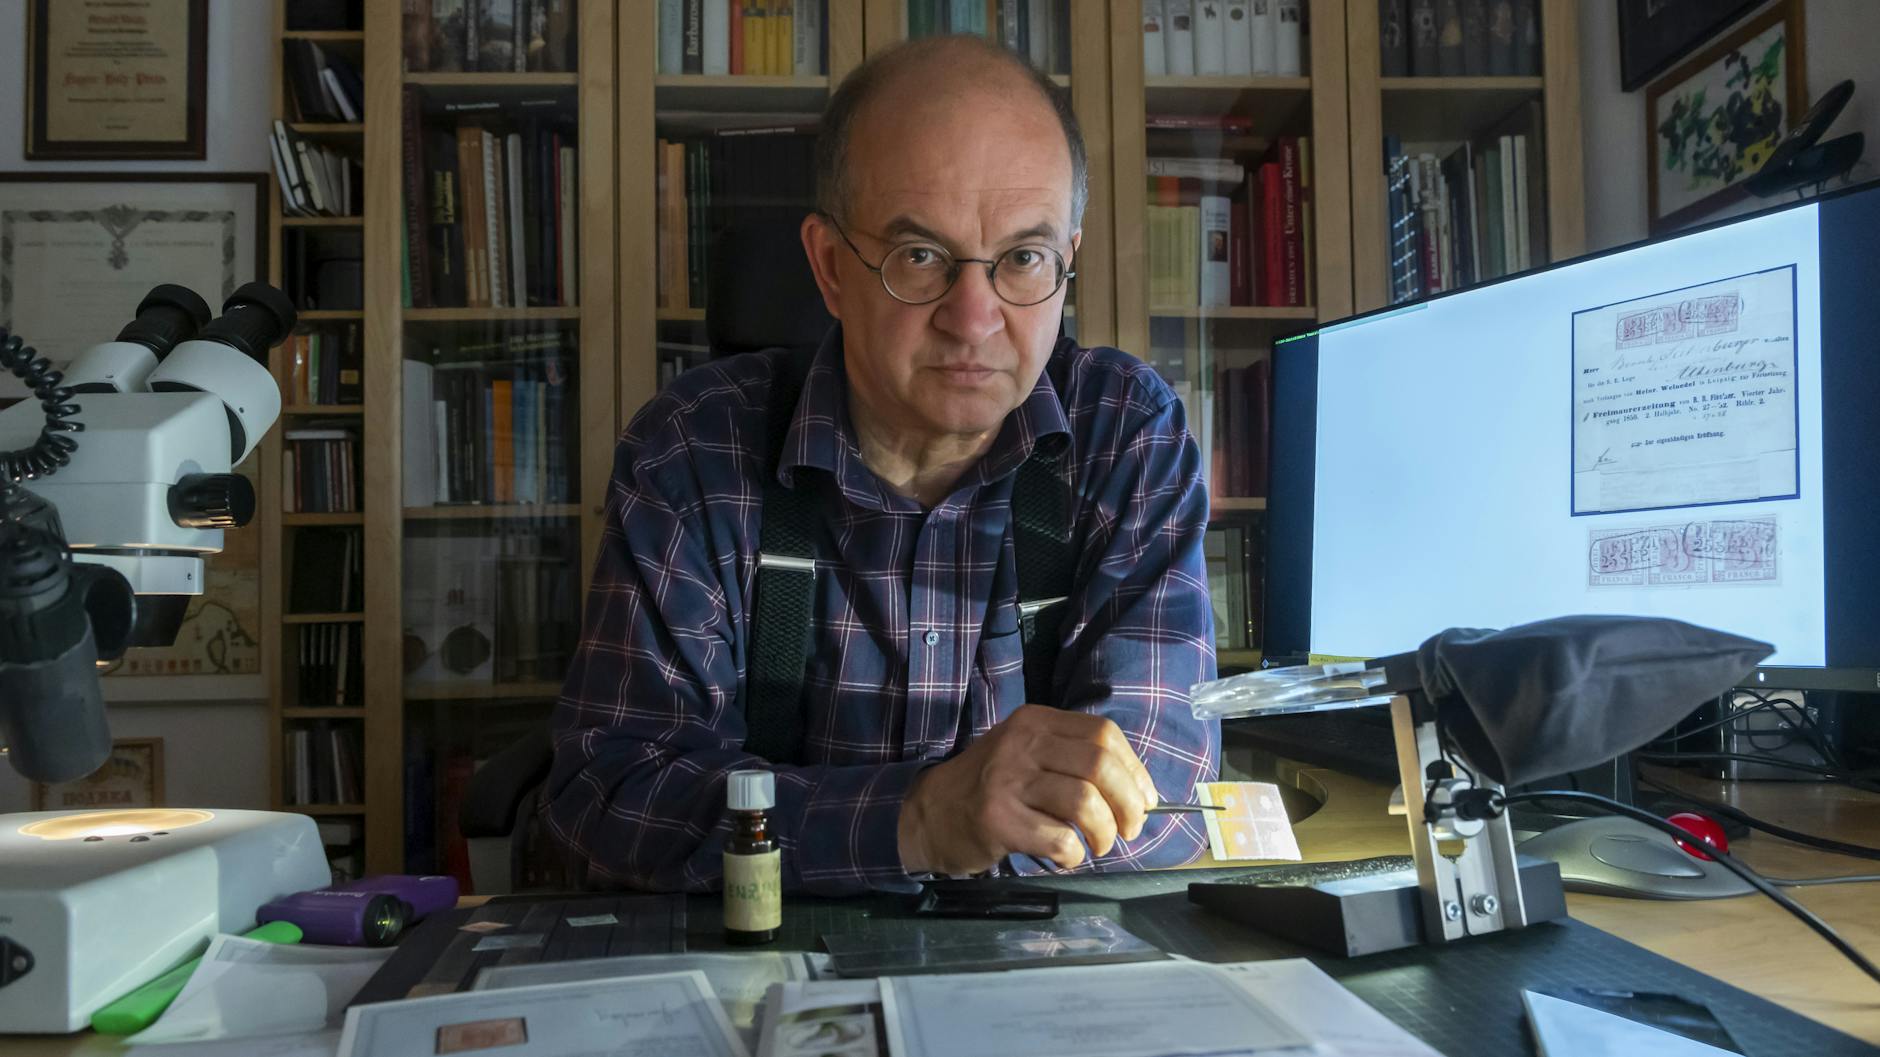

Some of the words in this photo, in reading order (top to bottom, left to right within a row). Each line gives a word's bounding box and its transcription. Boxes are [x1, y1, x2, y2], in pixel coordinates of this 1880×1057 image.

[1282, 146, 1294, 178] Krone
[1285, 205, 1295, 234] Unter
[1583, 367, 1600, 375] Herr
[1592, 400, 1676, 418] Freimaurerzeitung
